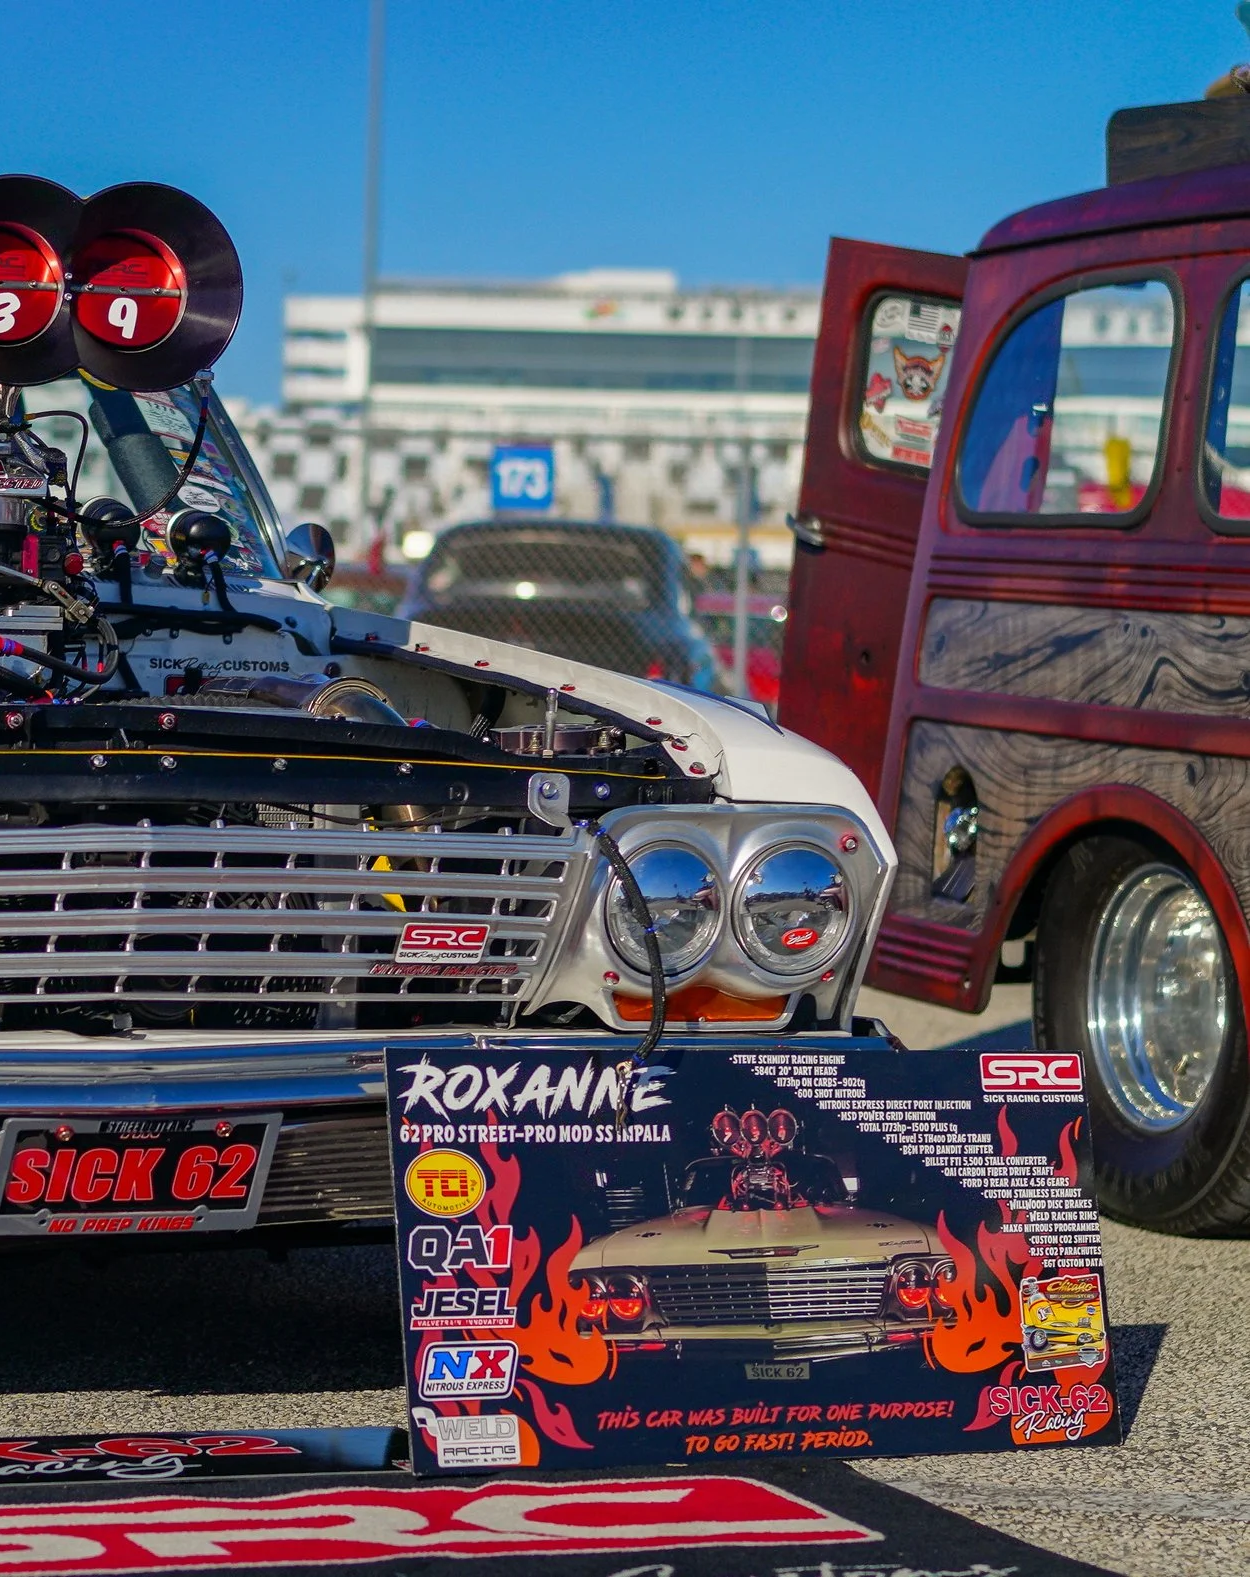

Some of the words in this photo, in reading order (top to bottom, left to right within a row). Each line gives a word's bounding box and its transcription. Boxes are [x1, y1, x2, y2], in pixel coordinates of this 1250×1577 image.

[108, 297, 138, 340] 9
[149, 658, 182, 670] SICK
[223, 660, 290, 672] CUSTOMS
[402, 930, 484, 946] SRC
[441, 951, 479, 959] CUSTOMS
[757, 1054, 790, 1064] SCHMIDT
[790, 1054, 818, 1064] RACING
[818, 1054, 845, 1064] ENGINE
[984, 1060, 1081, 1086] SRC
[813, 1088, 833, 1098] SHOT
[834, 1087, 866, 1098] NITROUS
[983, 1094, 1005, 1102] SICK
[1005, 1094, 1040, 1102] RACING
[1041, 1094, 1084, 1102] CUSTOMS
[851, 1099, 885, 1109] EXPRESS
[885, 1099, 912, 1109] DIRECT
[912, 1099, 933, 1109] PORT
[934, 1099, 971, 1110] INJECTION
[857, 1110, 885, 1121] POWER
[885, 1111, 904, 1121] GRID
[904, 1111, 936, 1121] IGNITION
[400, 1124, 420, 1142] 62
[420, 1124, 455, 1143] PRO
[457, 1124, 556, 1142] STREET-PRO
[558, 1124, 592, 1142] MOD
[594, 1124, 614, 1142] SS
[6, 1147, 166, 1204] SICK
[171, 1144, 258, 1201] 62
[417, 1169, 468, 1197] TCI
[1013, 1188, 1049, 1198] STAINLESS
[1050, 1188, 1082, 1198] EXHAUST
[421, 1198, 471, 1212] AUTOMOTIVE
[1050, 1211, 1077, 1221] RACING
[1078, 1210, 1097, 1220] RIMS
[47, 1216, 77, 1233] NO
[82, 1216, 131, 1232] PREP
[137, 1215, 197, 1232] KINGS
[1073, 1234, 1101, 1243] SHIFTER
[408, 1225, 513, 1275] QA1
[1056, 1258, 1084, 1267] CUSTOM
[1084, 1257, 1103, 1267] DATA
[413, 1289, 515, 1317] JESEL
[417, 1319, 462, 1327] VALVETRAIN
[465, 1318, 509, 1326] INNOVATION
[429, 1350, 510, 1380] NX
[751, 1366, 783, 1378] SICK
[786, 1366, 805, 1378] 62
[425, 1381, 465, 1393] NITROUS
[466, 1380, 506, 1391] EXPRESS
[989, 1385, 1109, 1416] SICK-62
[596, 1406, 641, 1429] THIS
[645, 1410, 683, 1427] CAR
[686, 1408, 726, 1426] WAS
[729, 1406, 783, 1424] BUILT
[785, 1405, 822, 1422] FOR
[825, 1403, 864, 1421] ONE
[866, 1401, 954, 1418] PURPOSE!
[437, 1417, 516, 1441] WELD
[1015, 1408, 1086, 1441] Racing
[685, 1434, 710, 1454] TO
[713, 1434, 740, 1452] GO
[743, 1432, 795, 1450] FAST!
[799, 1426, 873, 1448] PERIOD.
[443, 1445, 516, 1456] RACING
